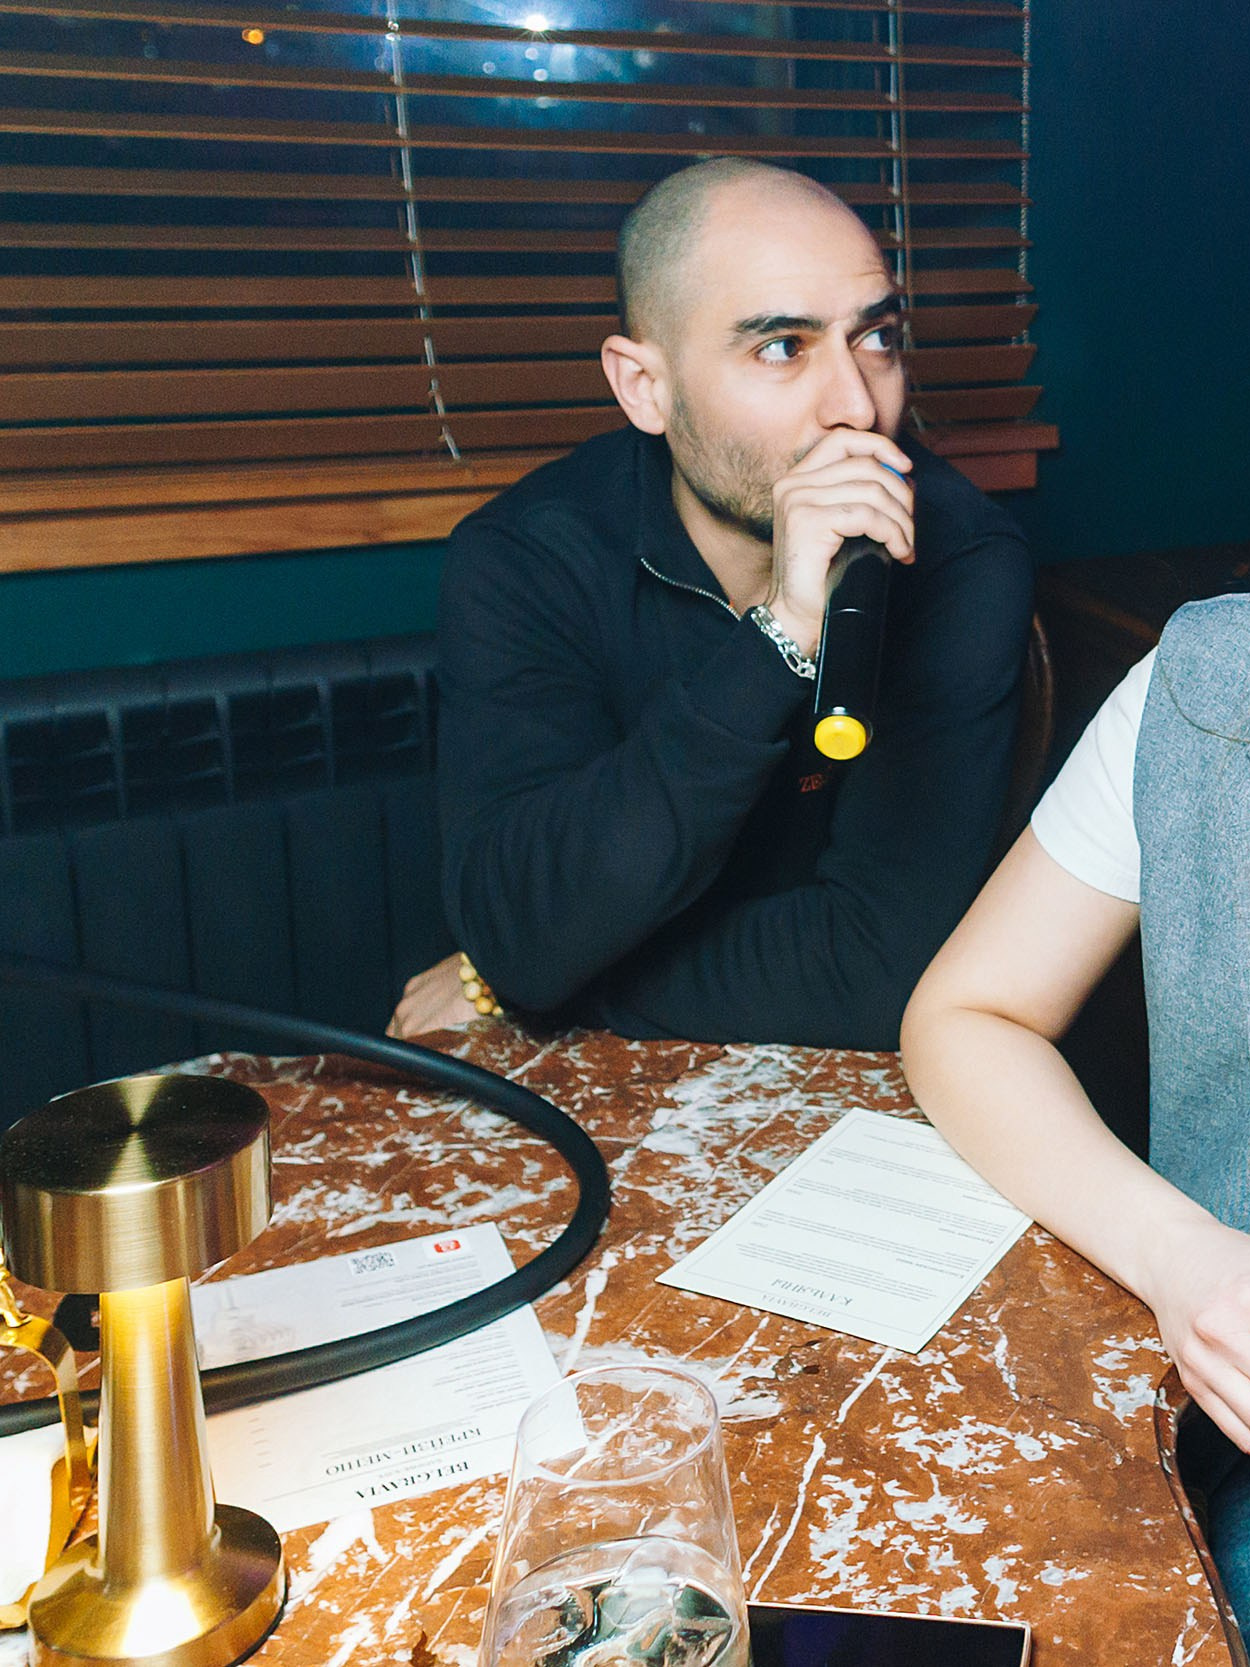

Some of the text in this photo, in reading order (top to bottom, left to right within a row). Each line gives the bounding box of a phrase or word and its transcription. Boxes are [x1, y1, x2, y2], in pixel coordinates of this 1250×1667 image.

[770, 1278, 854, 1308] КАЛЬЯНЫ
[324, 1427, 482, 1477] КРЕЙЗИ-МЕНЮ
[353, 1461, 469, 1500] BELGRAVIA
